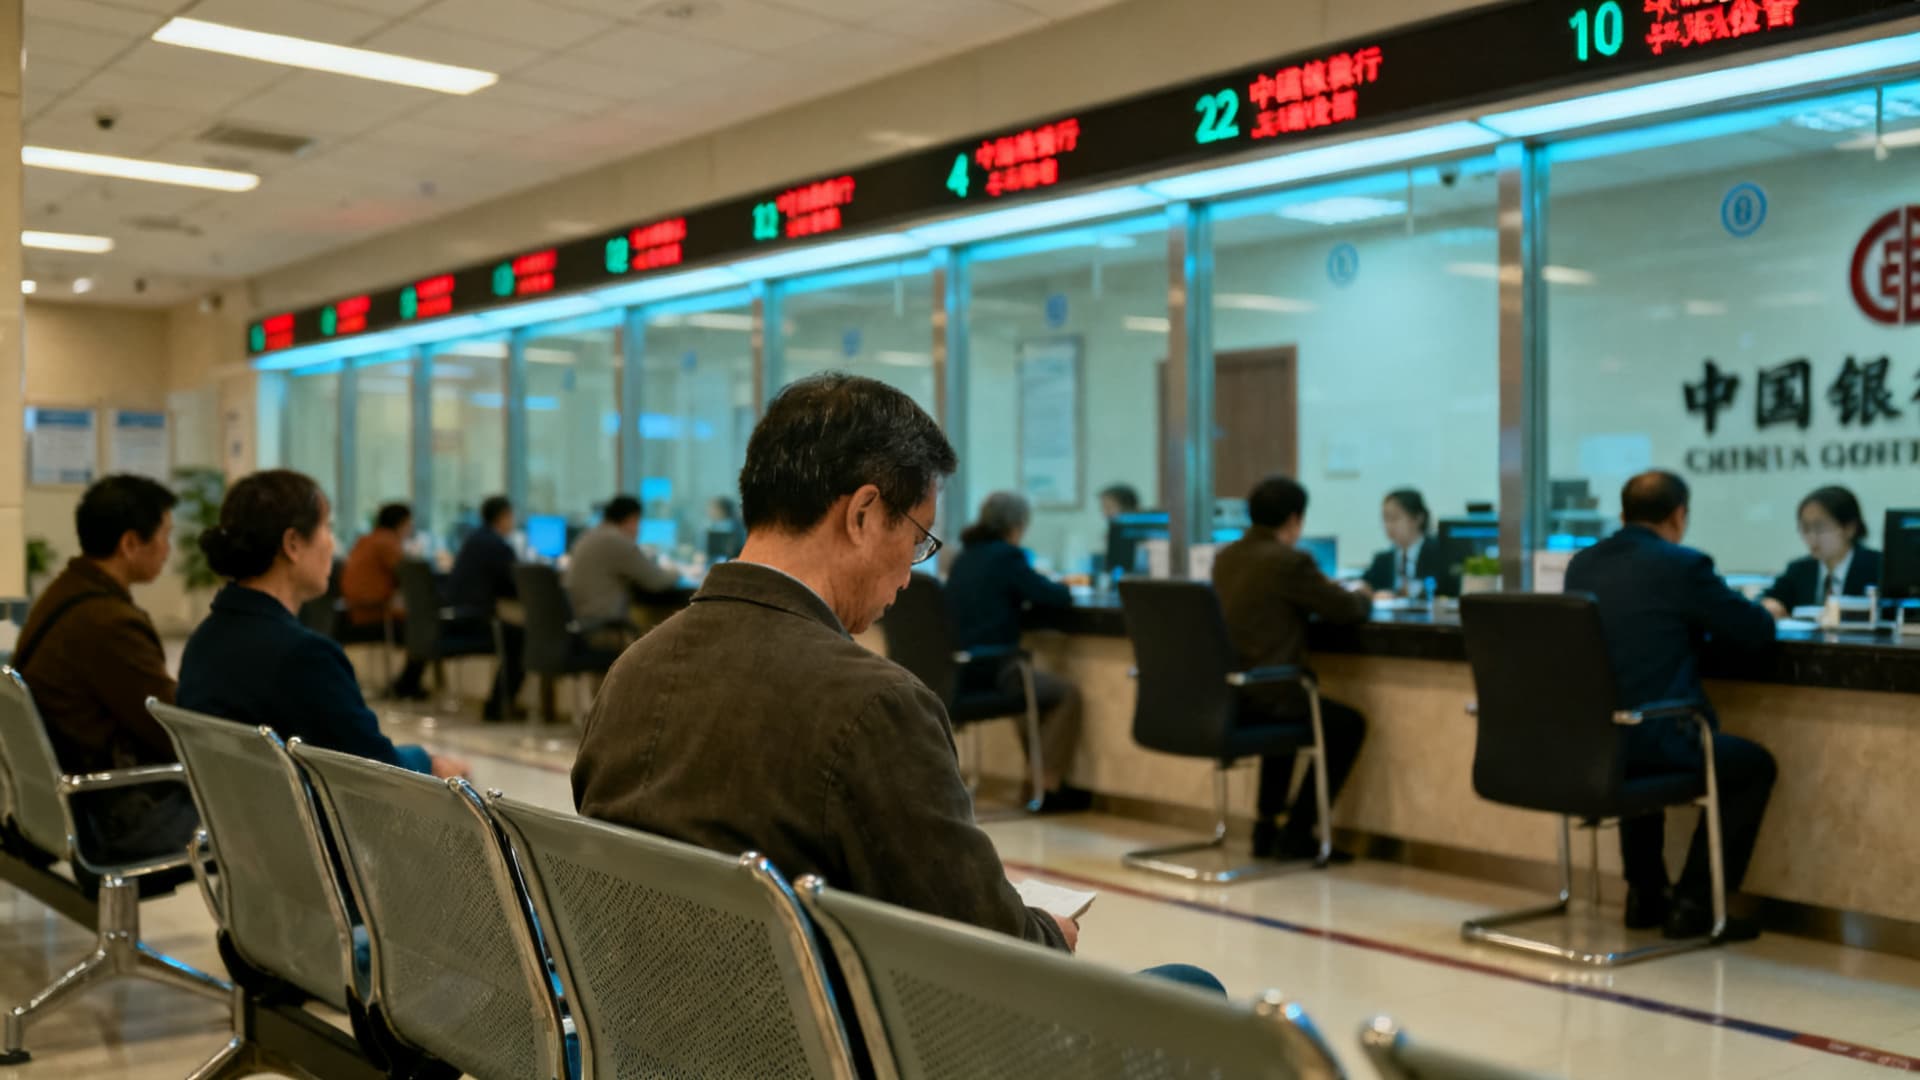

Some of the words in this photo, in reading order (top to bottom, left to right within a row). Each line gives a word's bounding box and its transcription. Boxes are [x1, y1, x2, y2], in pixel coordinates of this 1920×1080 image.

[1569, 0, 1624, 62] 10
[1195, 88, 1240, 144] 22
[946, 153, 970, 198] 4
